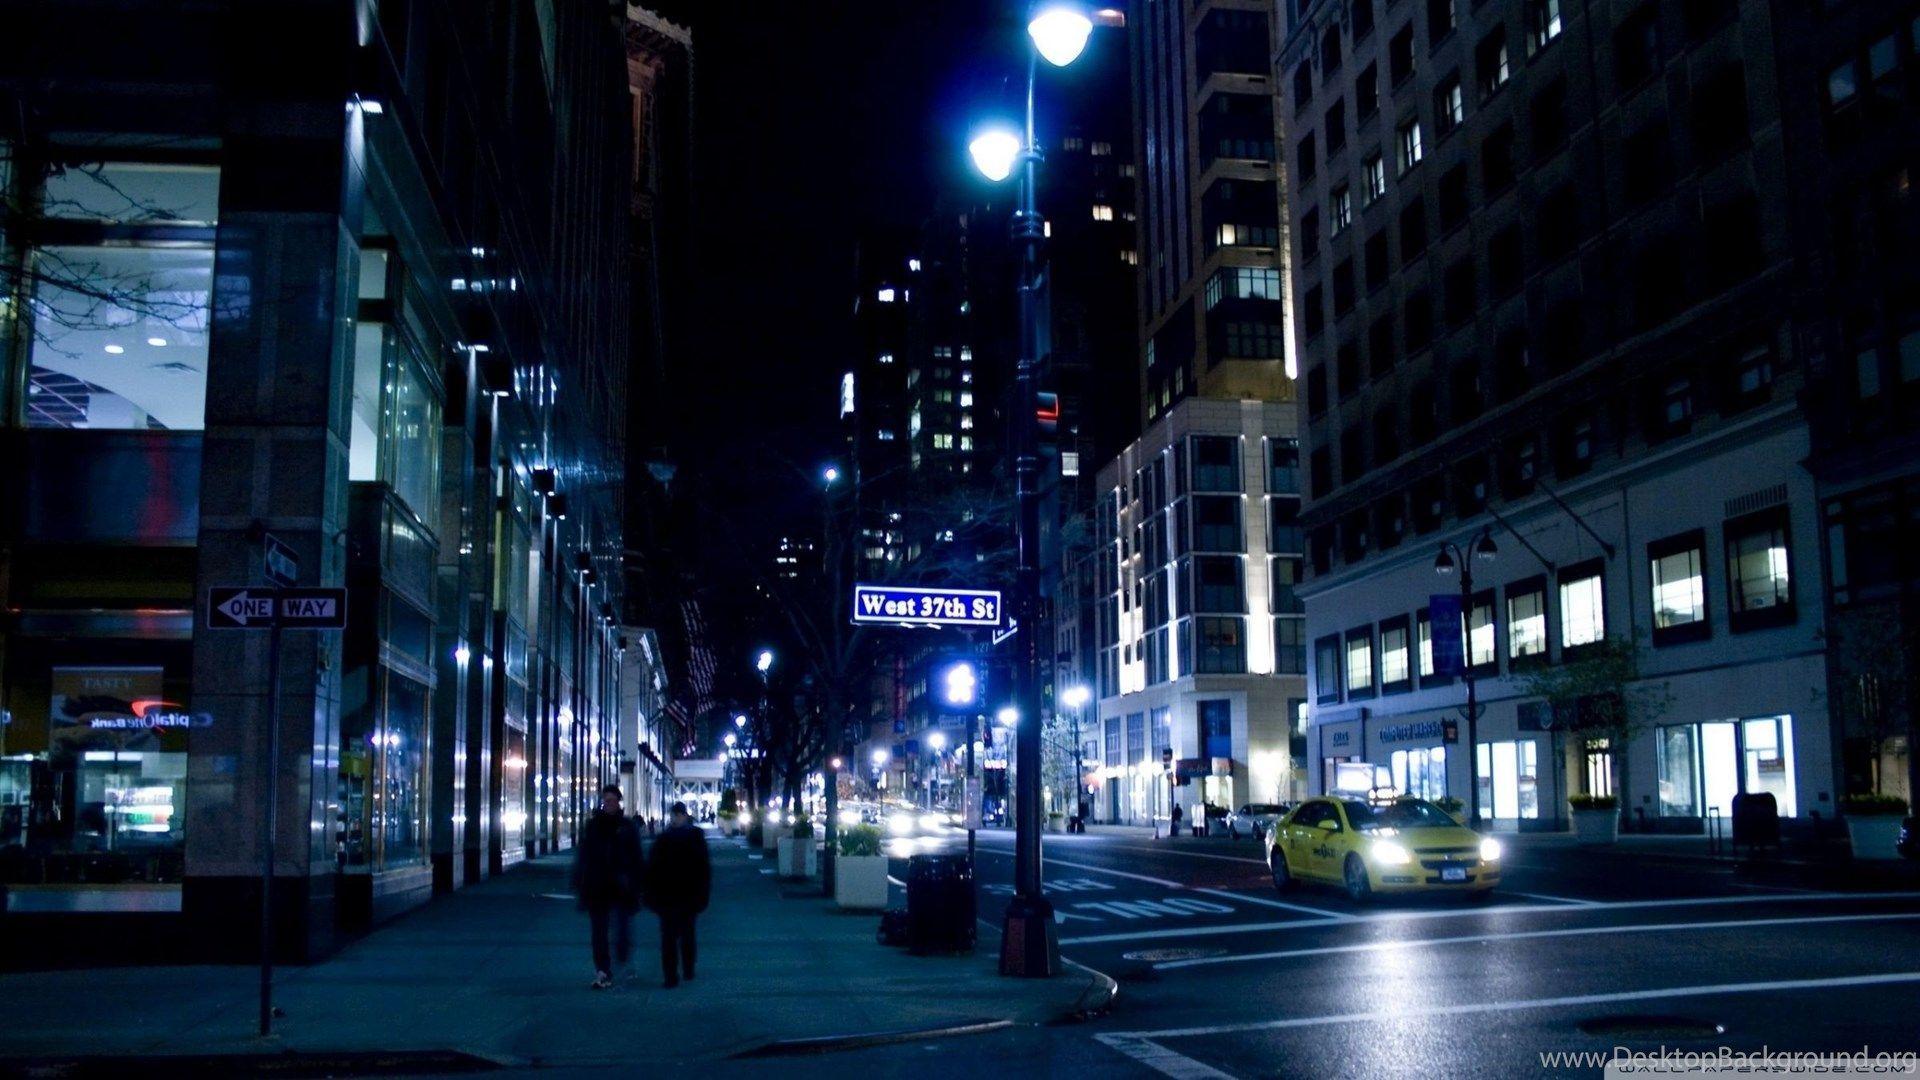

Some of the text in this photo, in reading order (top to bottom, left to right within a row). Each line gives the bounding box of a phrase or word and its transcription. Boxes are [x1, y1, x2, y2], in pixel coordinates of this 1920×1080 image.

[230, 600, 328, 615] ONE WAY
[861, 594, 995, 619] West 37th St
